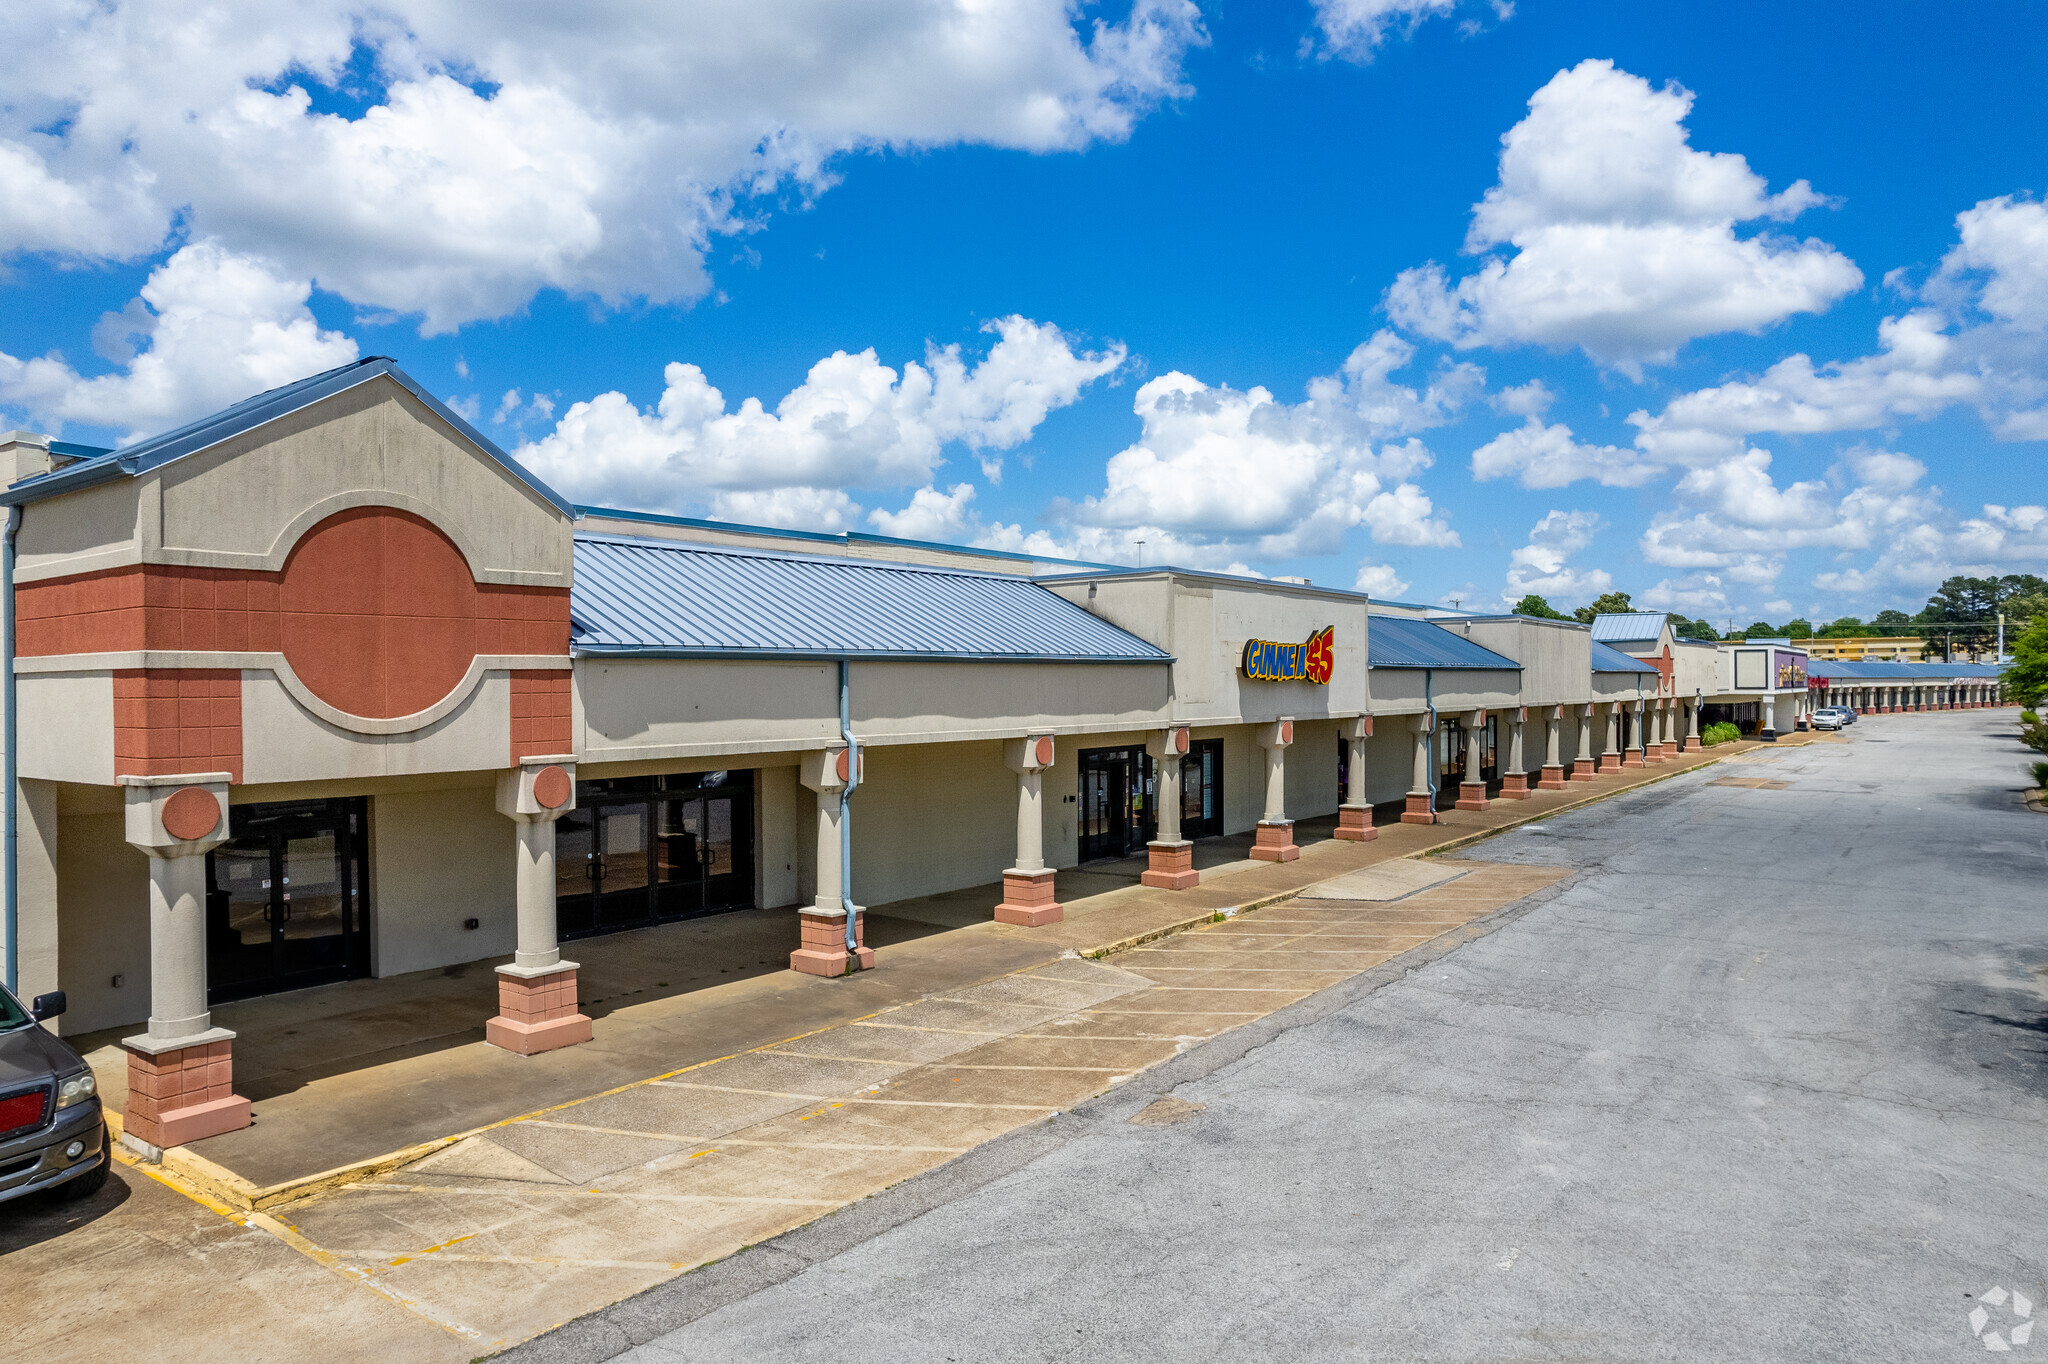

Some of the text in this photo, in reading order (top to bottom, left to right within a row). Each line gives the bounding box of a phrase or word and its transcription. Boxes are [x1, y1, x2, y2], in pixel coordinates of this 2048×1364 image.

[1247, 626, 1334, 685] GIMME A $5
